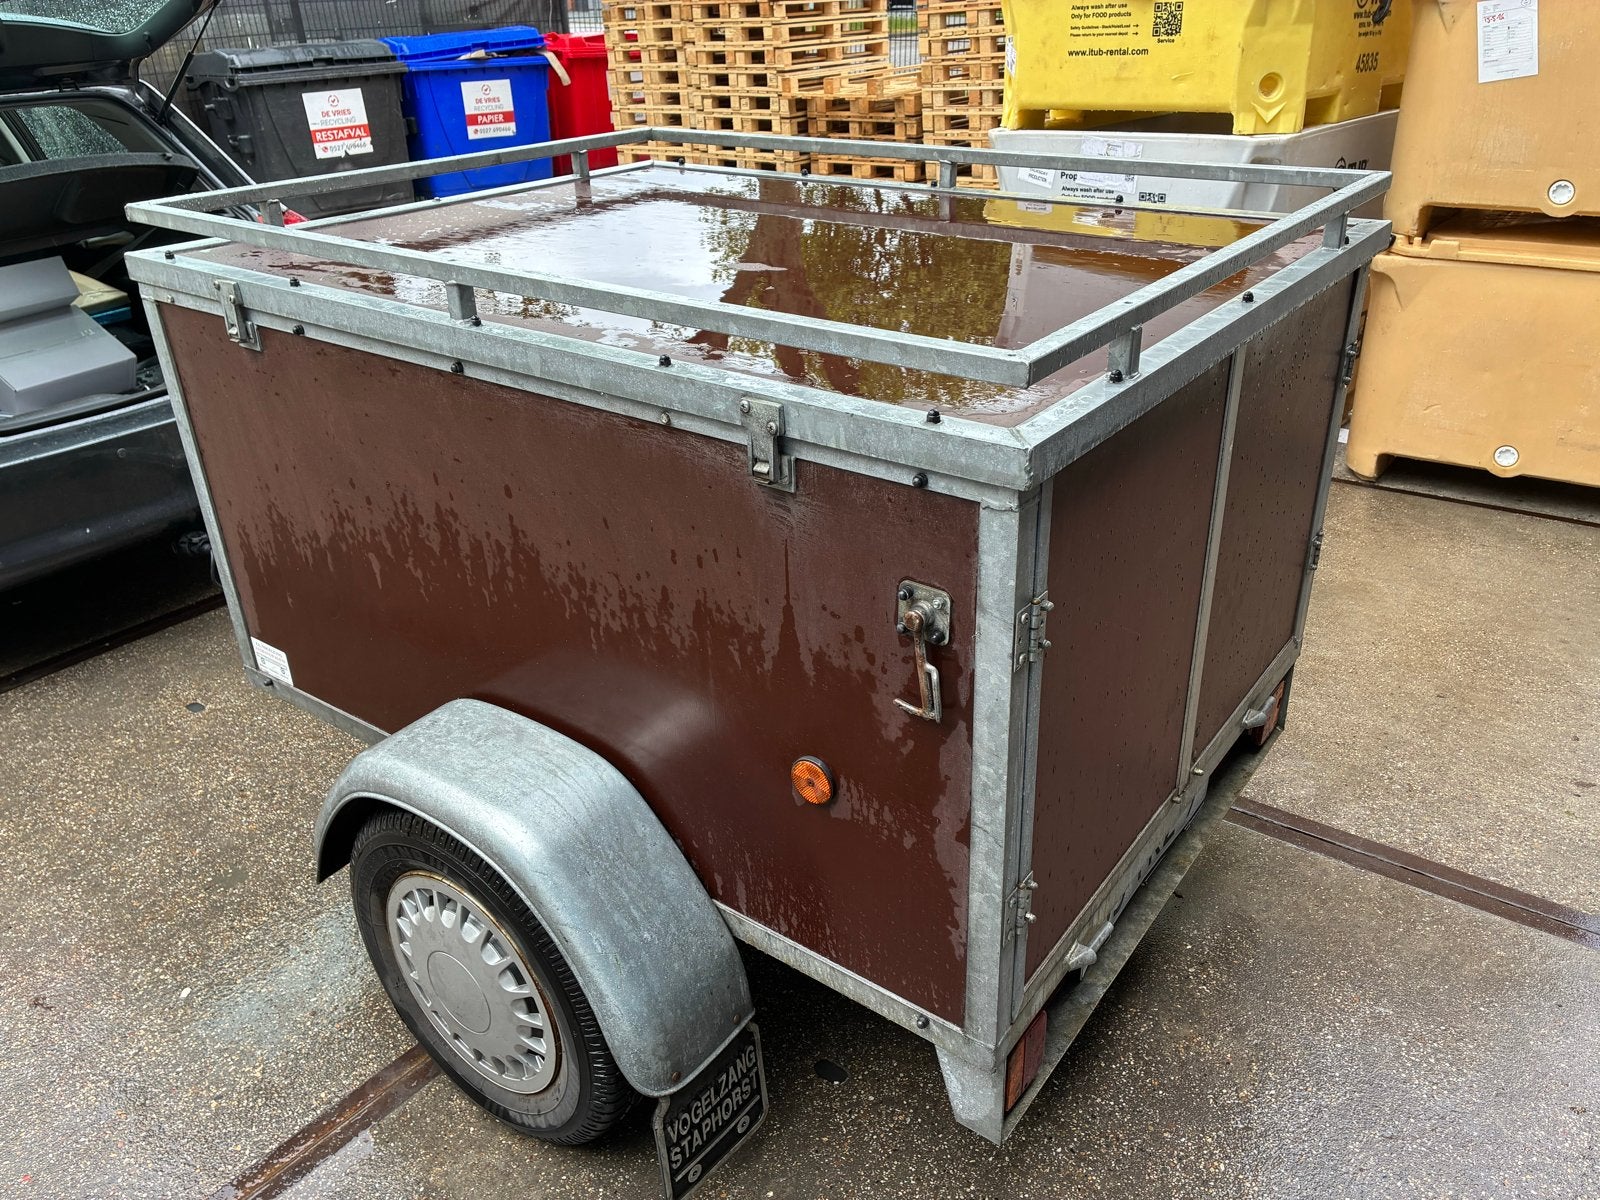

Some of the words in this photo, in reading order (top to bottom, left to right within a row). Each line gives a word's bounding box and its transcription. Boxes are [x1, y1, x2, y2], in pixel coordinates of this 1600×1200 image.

[1067, 47, 1149, 57] www.itub-rental.com
[1355, 51, 1379, 73] 45835
[332, 109, 352, 117] VRIES
[320, 116, 357, 127] RECYCLING
[477, 114, 505, 124] PAPIER
[315, 126, 368, 142] RESTAFVAL
[1061, 185, 1079, 193] Always
[667, 1045, 757, 1143] VOGELZANG
[670, 1066, 758, 1170] STAPHORST
